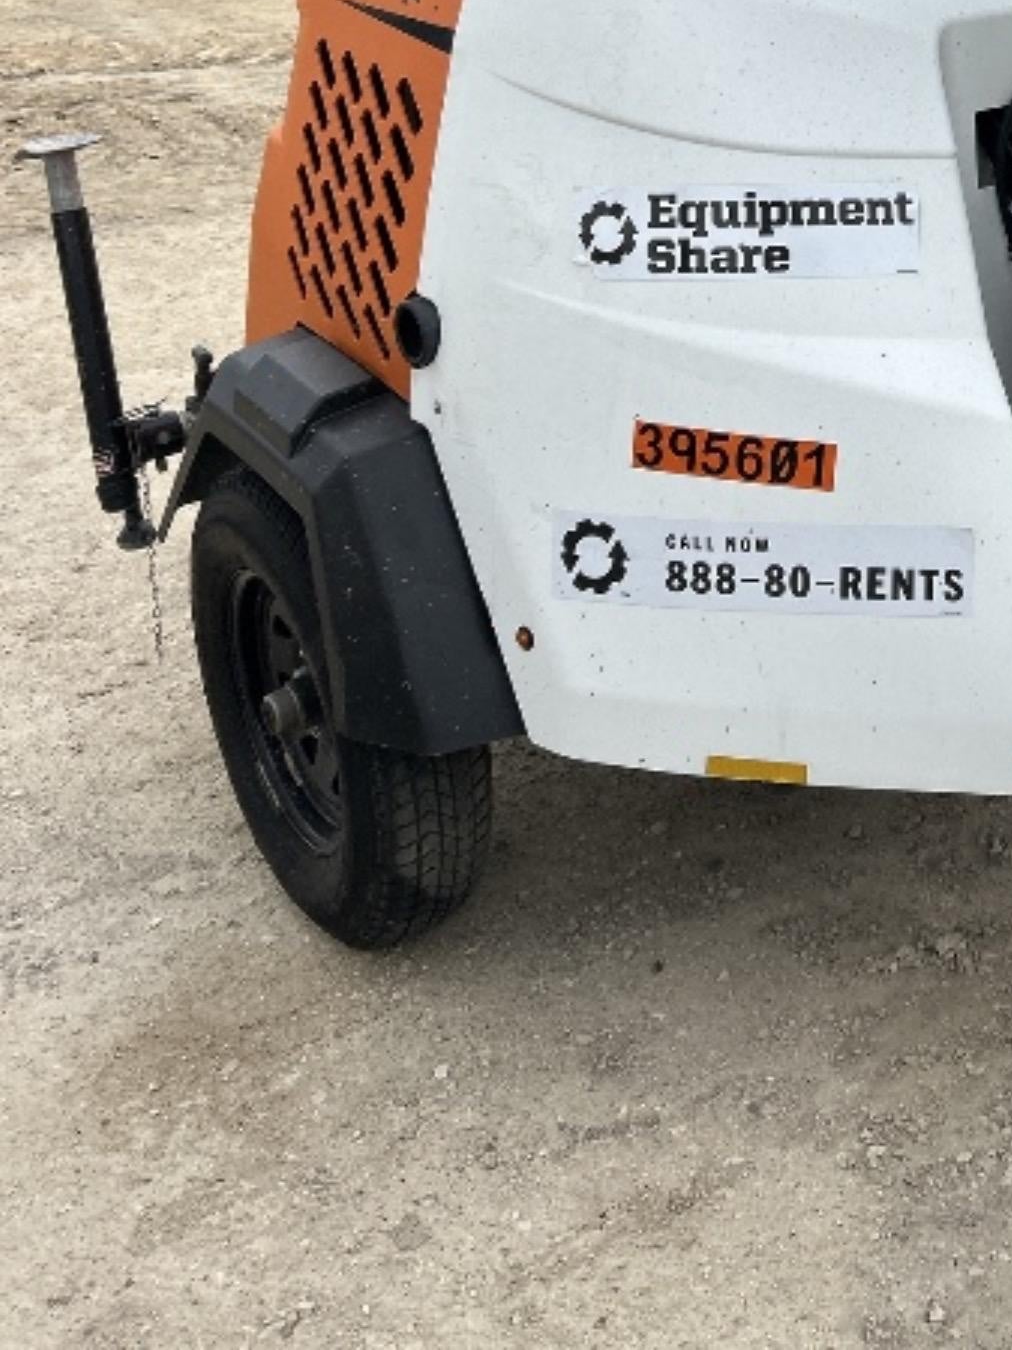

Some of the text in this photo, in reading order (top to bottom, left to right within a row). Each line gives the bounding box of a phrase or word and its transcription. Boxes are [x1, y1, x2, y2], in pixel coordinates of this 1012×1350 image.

[646, 191, 914, 238] Equipment
[646, 238, 791, 274] Share
[634, 421, 828, 488] 395601
[665, 533, 769, 552] CALL NOW
[664, 560, 965, 603] 888-80-RENTS
